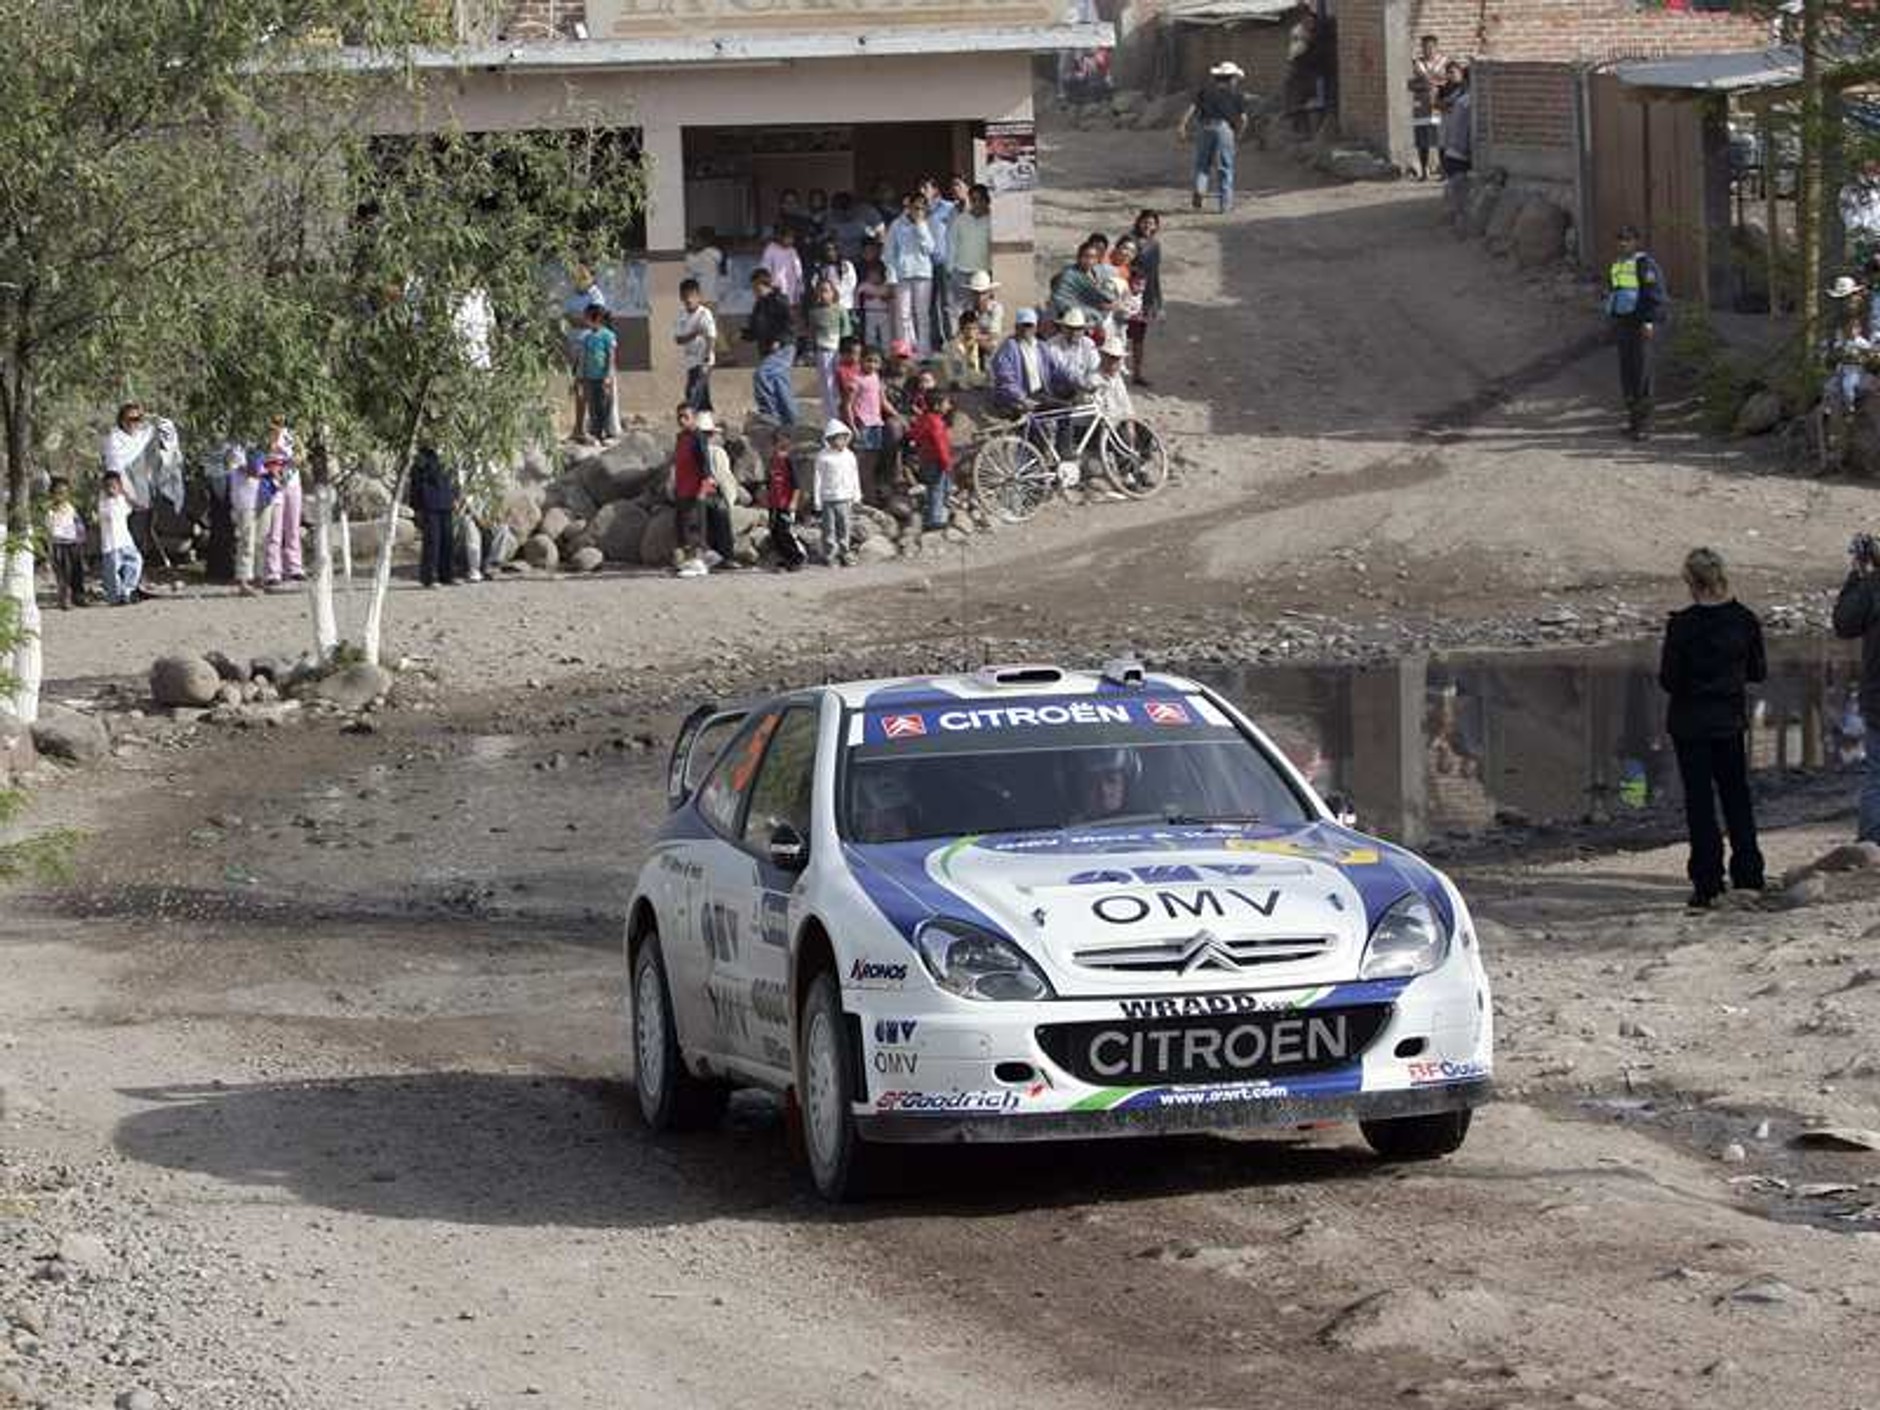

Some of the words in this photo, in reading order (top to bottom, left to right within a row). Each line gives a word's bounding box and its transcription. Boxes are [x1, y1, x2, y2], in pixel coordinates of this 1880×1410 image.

[938, 702, 1131, 731] CITROËN
[1091, 889, 1281, 925] OMV
[874, 1051, 919, 1075] OMV
[875, 1089, 1022, 1111] BFGoodrich
